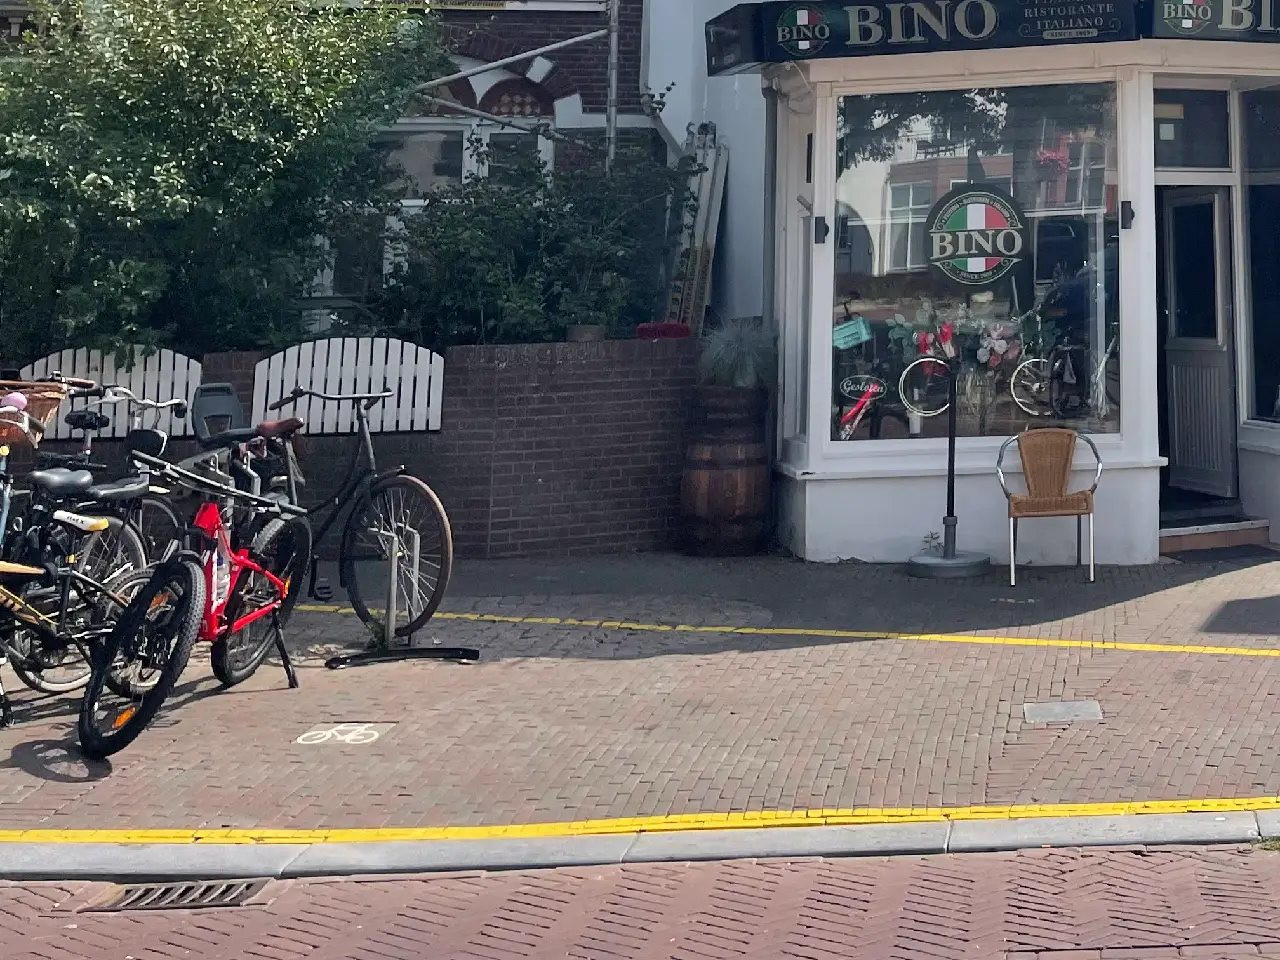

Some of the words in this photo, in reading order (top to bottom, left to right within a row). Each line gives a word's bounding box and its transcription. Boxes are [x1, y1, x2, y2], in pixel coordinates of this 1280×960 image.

[1024, 3, 1115, 18] RISTORANTE
[1163, 2, 1211, 19] BINO
[1036, 16, 1104, 30] ITALIANO
[777, 23, 830, 42] BINO
[929, 229, 1023, 261] BINO
[843, 380, 884, 394] Gesloten
